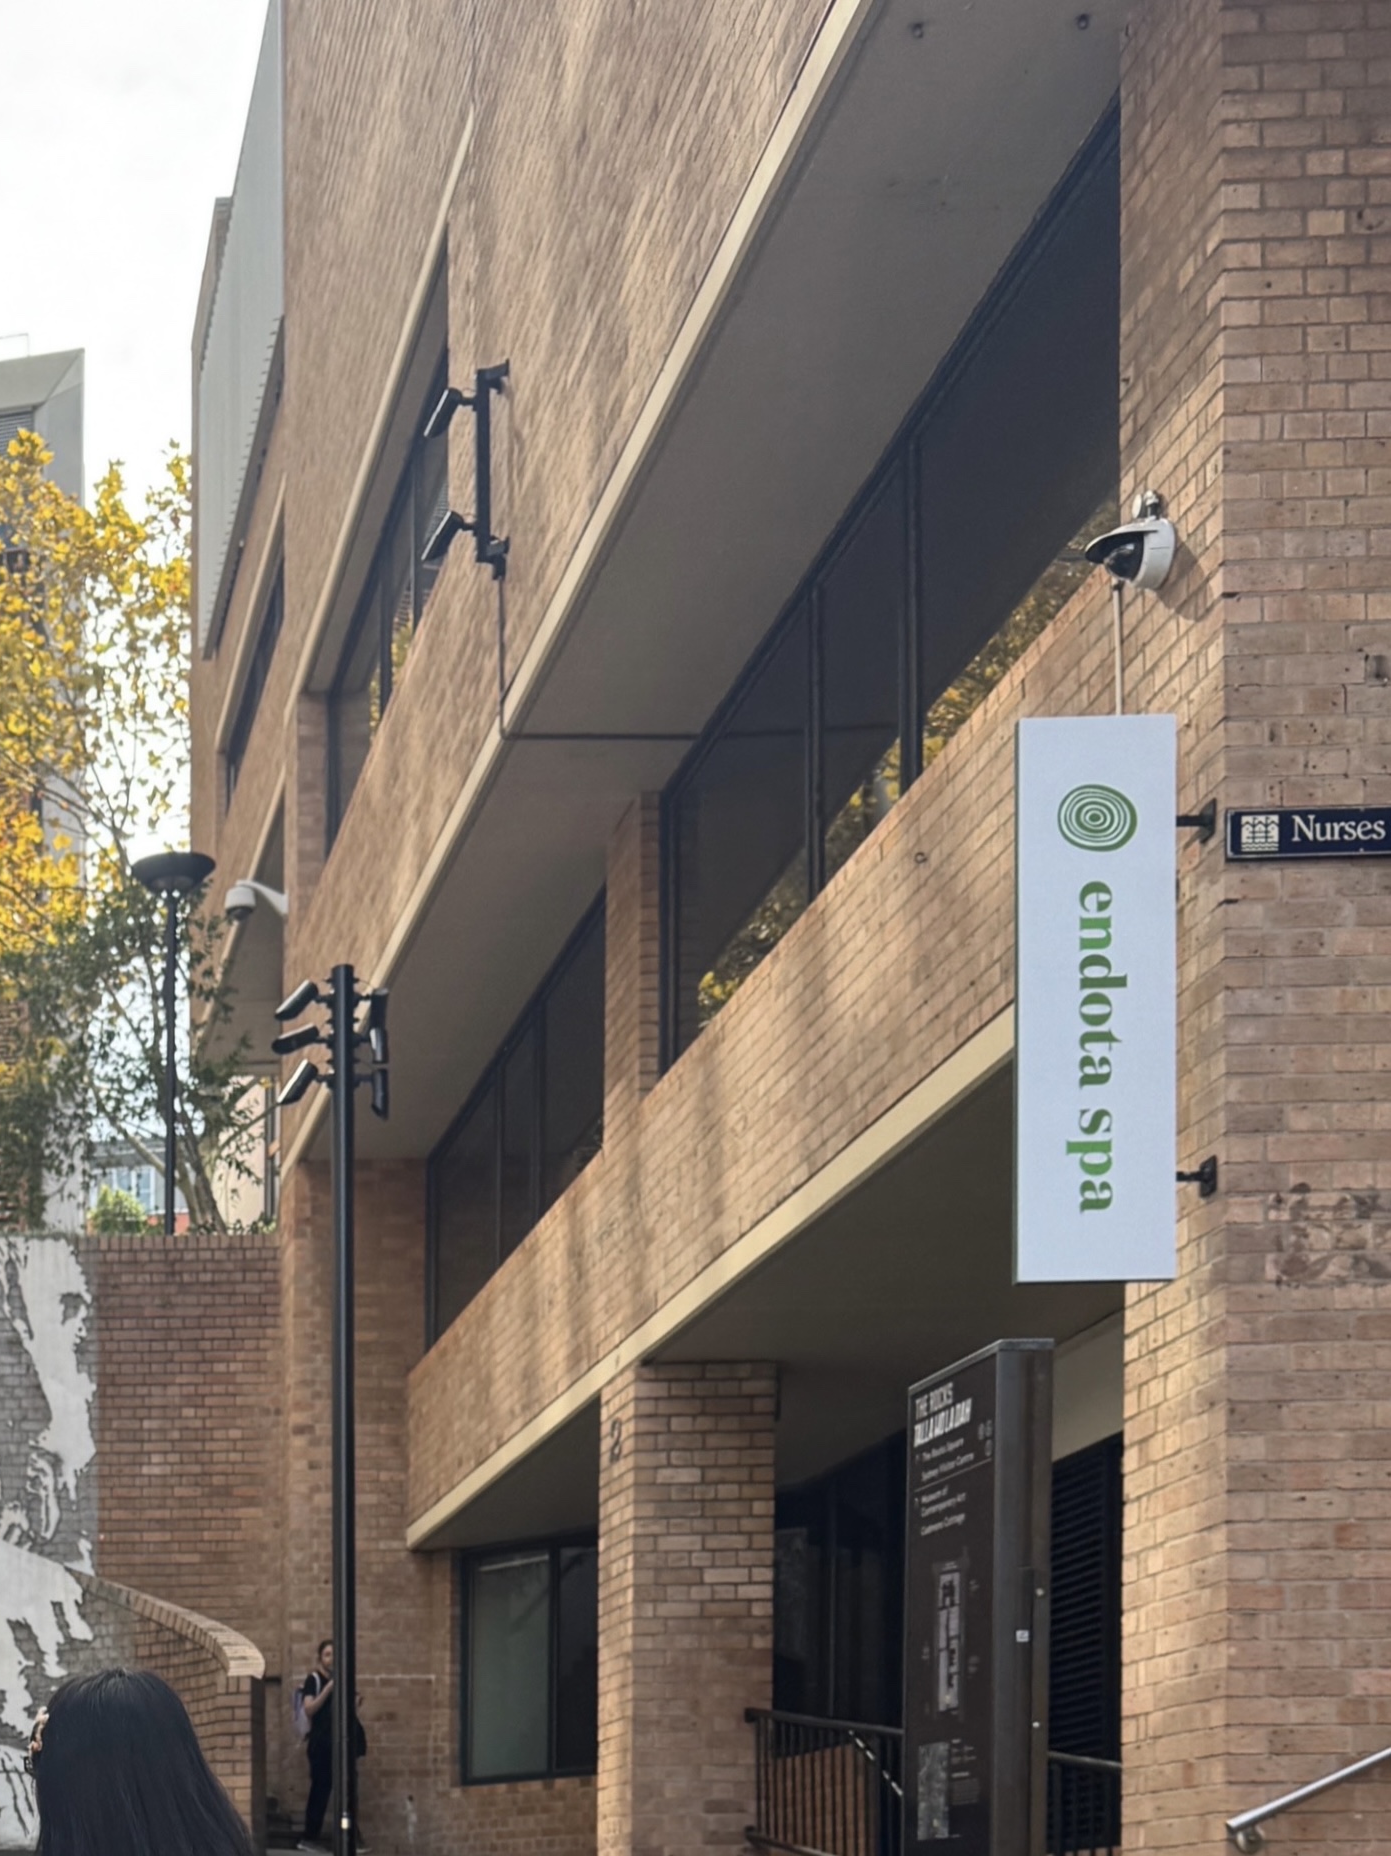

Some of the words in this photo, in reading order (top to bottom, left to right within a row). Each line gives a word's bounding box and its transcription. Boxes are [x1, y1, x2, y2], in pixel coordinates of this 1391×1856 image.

[1291, 814, 1387, 842] Nurses
[1078, 880, 1128, 1090] endota
[1065, 1107, 1114, 1213] spa
